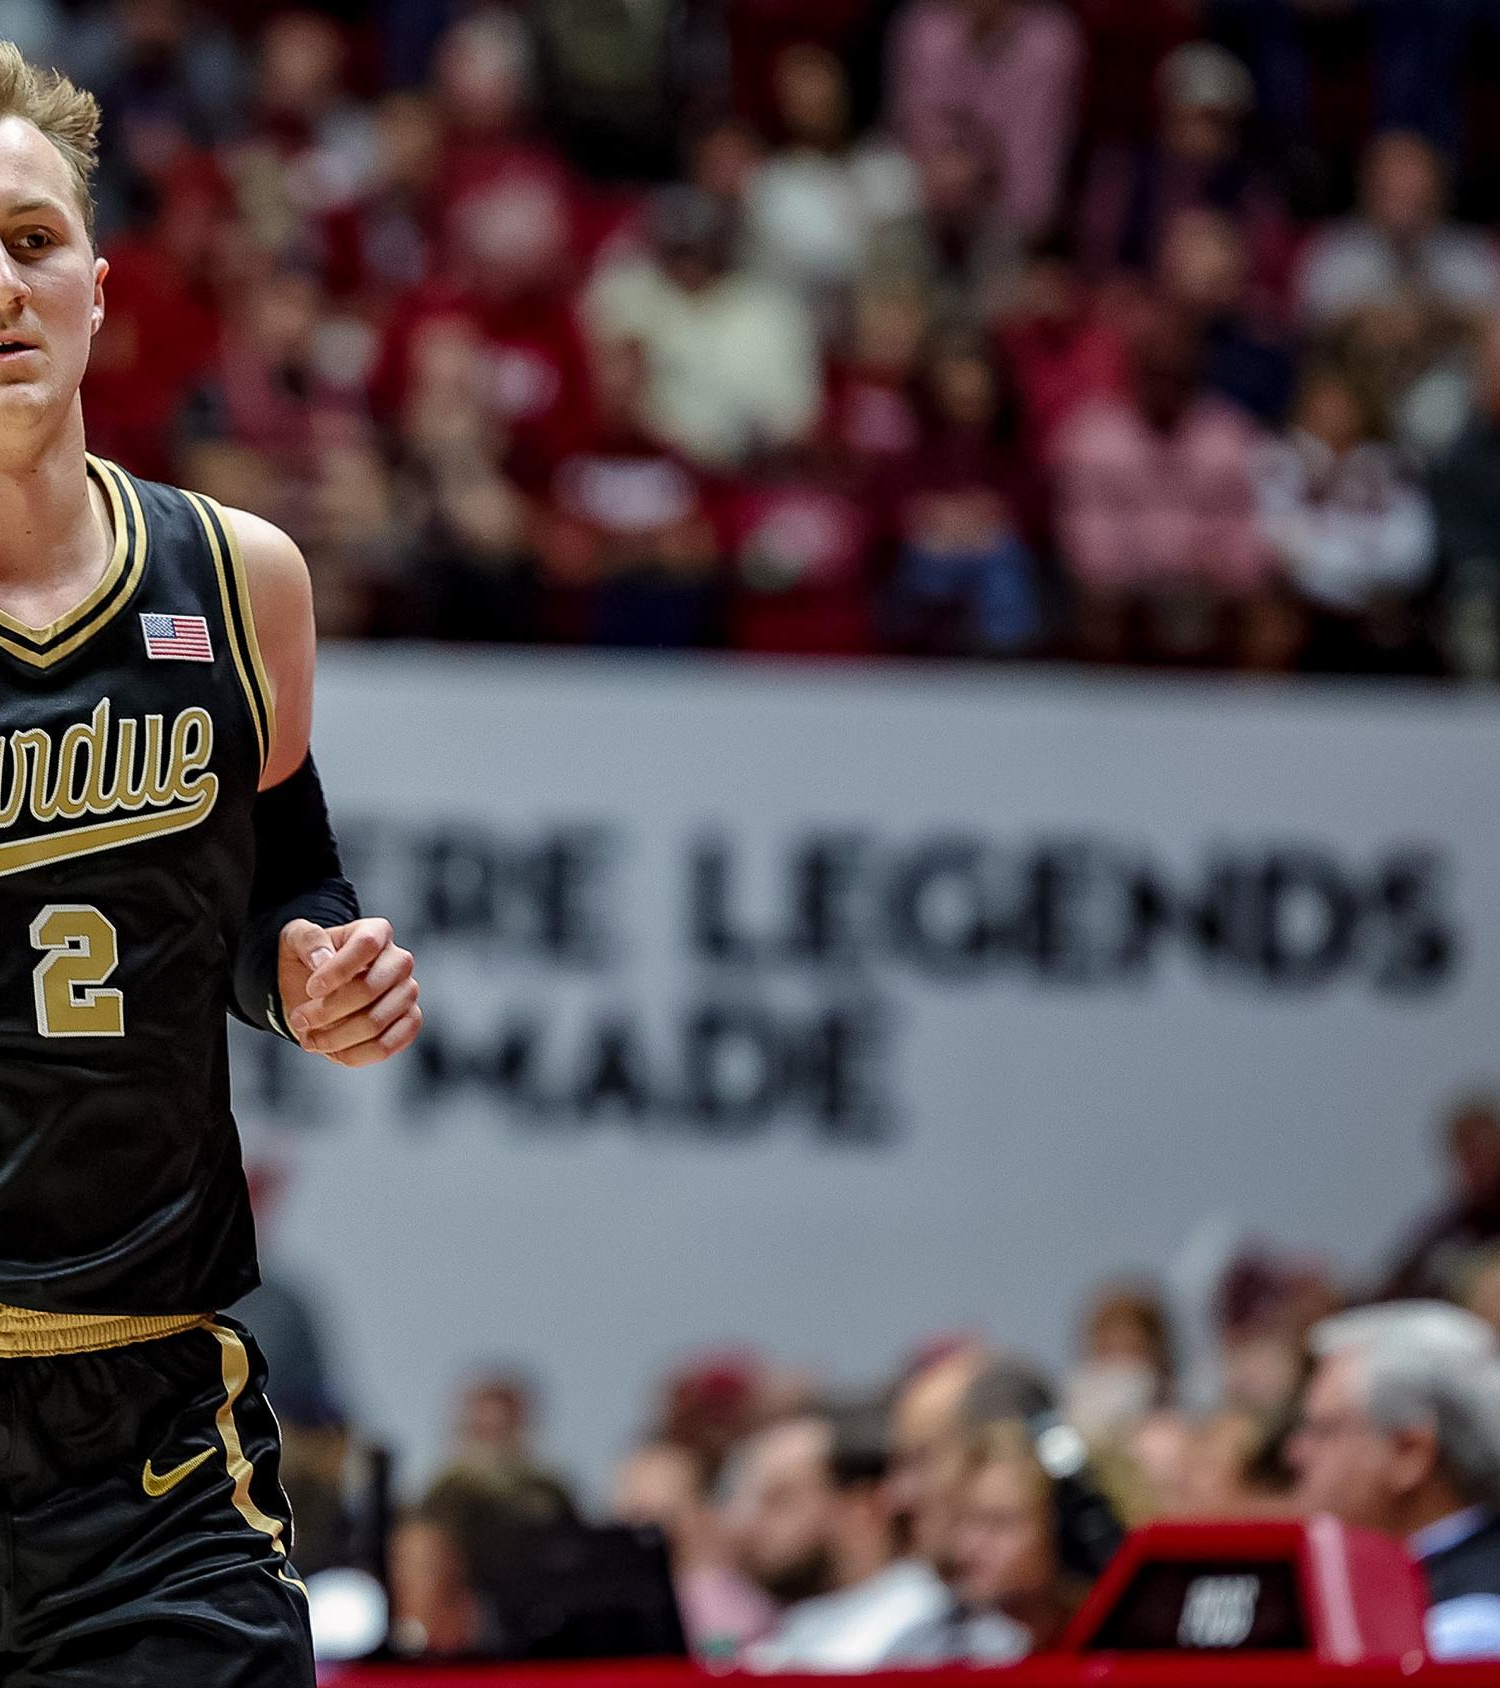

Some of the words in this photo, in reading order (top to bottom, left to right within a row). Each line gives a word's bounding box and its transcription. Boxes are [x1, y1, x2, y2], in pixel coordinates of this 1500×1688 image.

[29, 904, 124, 1037] 2
[690, 824, 1452, 996] LEGENDS
[402, 1000, 895, 1148] MADE
